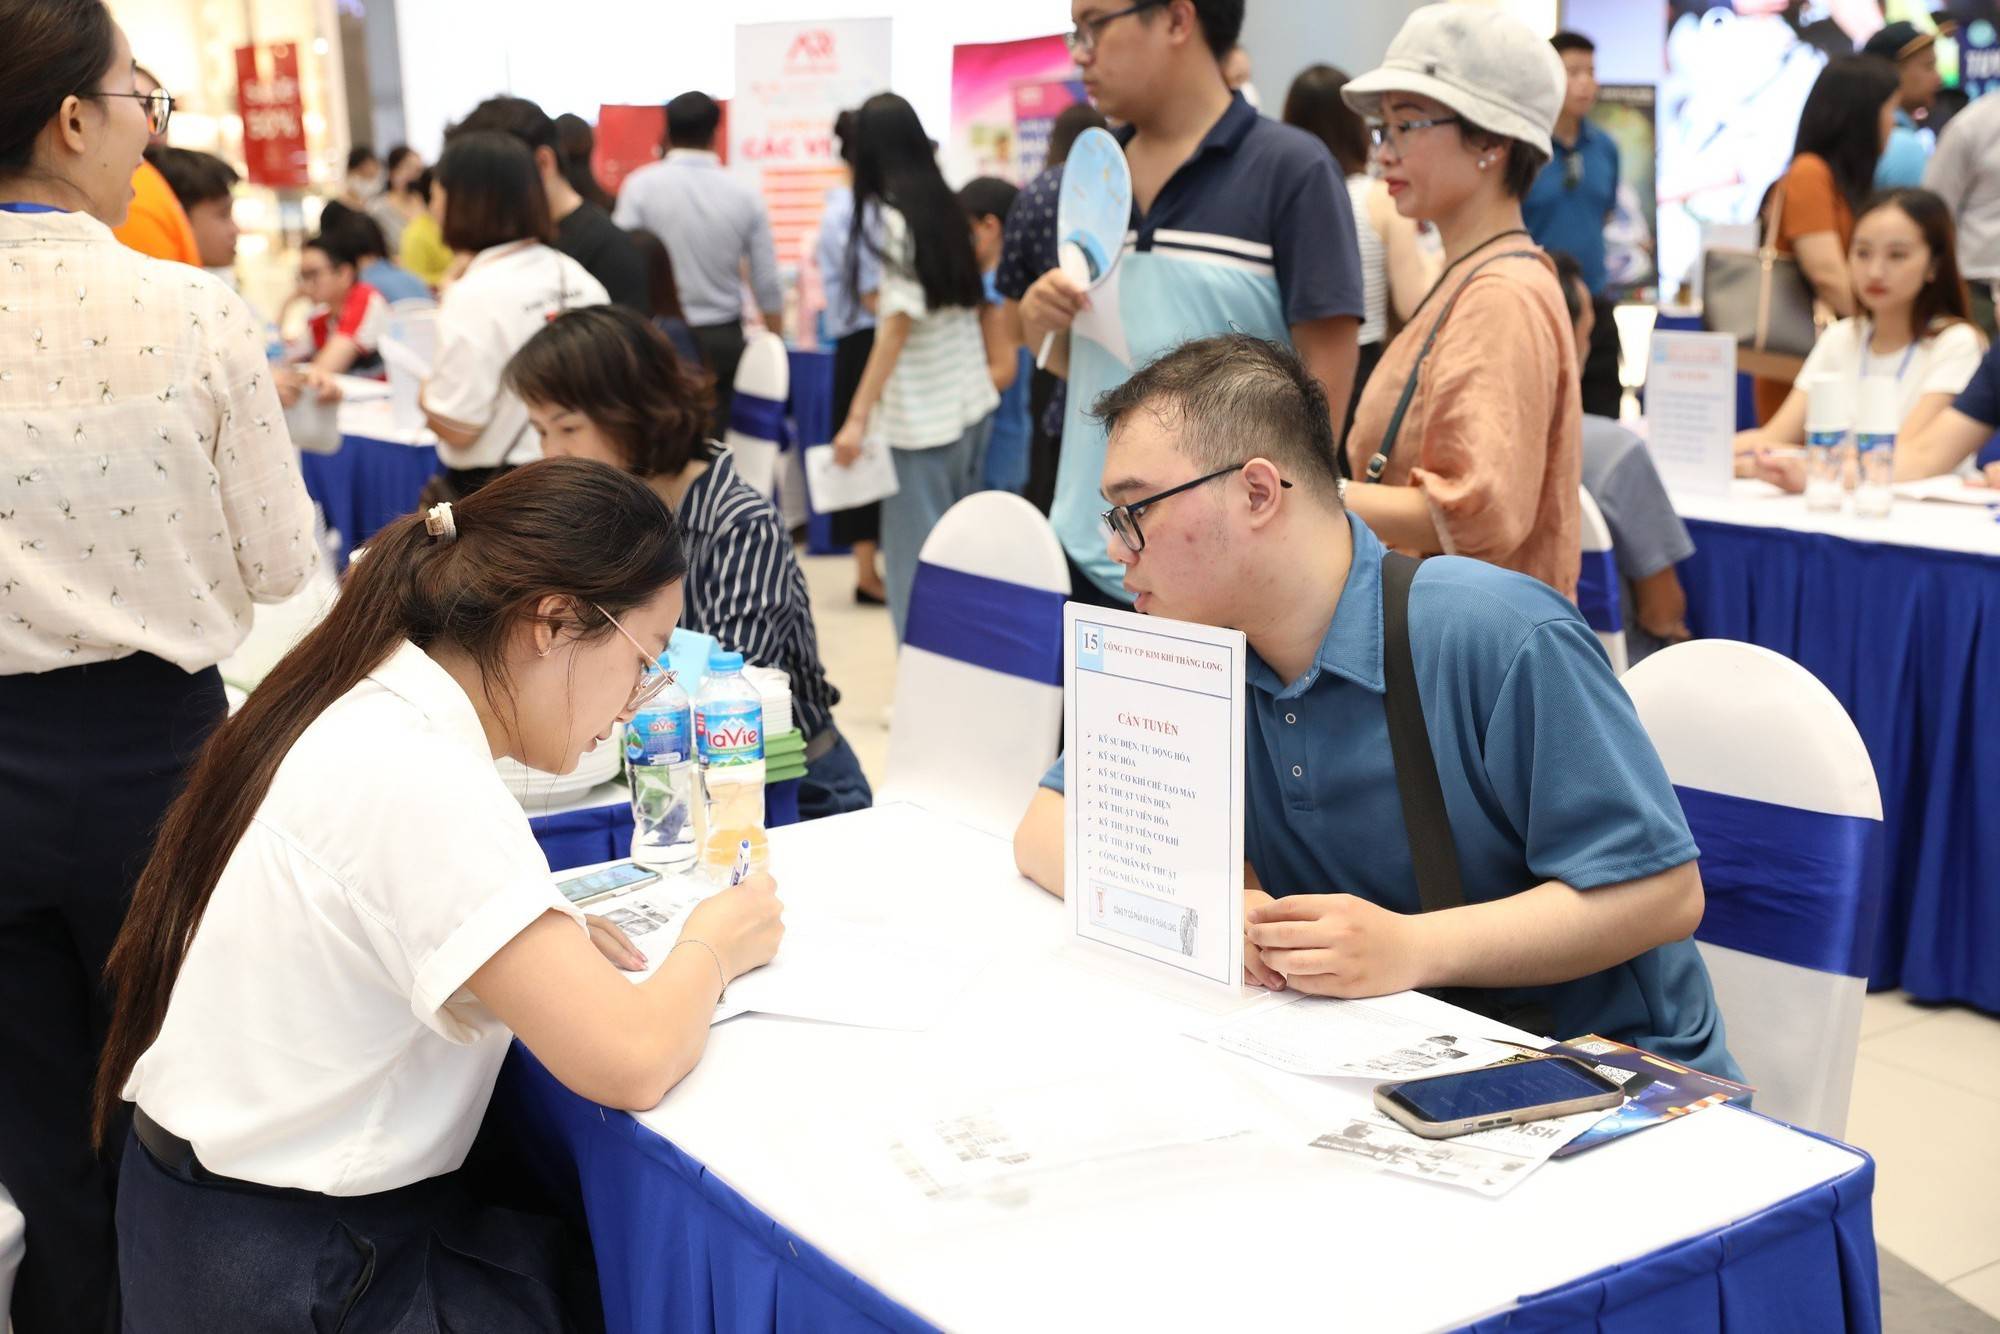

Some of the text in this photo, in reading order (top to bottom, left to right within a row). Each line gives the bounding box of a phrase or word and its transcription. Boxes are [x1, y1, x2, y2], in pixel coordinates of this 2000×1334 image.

[1084, 632, 1098, 650] 15
[1103, 640, 1123, 654] CÔNG
[1124, 646, 1133, 655] TY
[1134, 648, 1145, 657] CP
[1145, 650, 1160, 660] KIM
[1160, 651, 1174, 662] KHÍ
[1202, 661, 1223, 672] LONG
